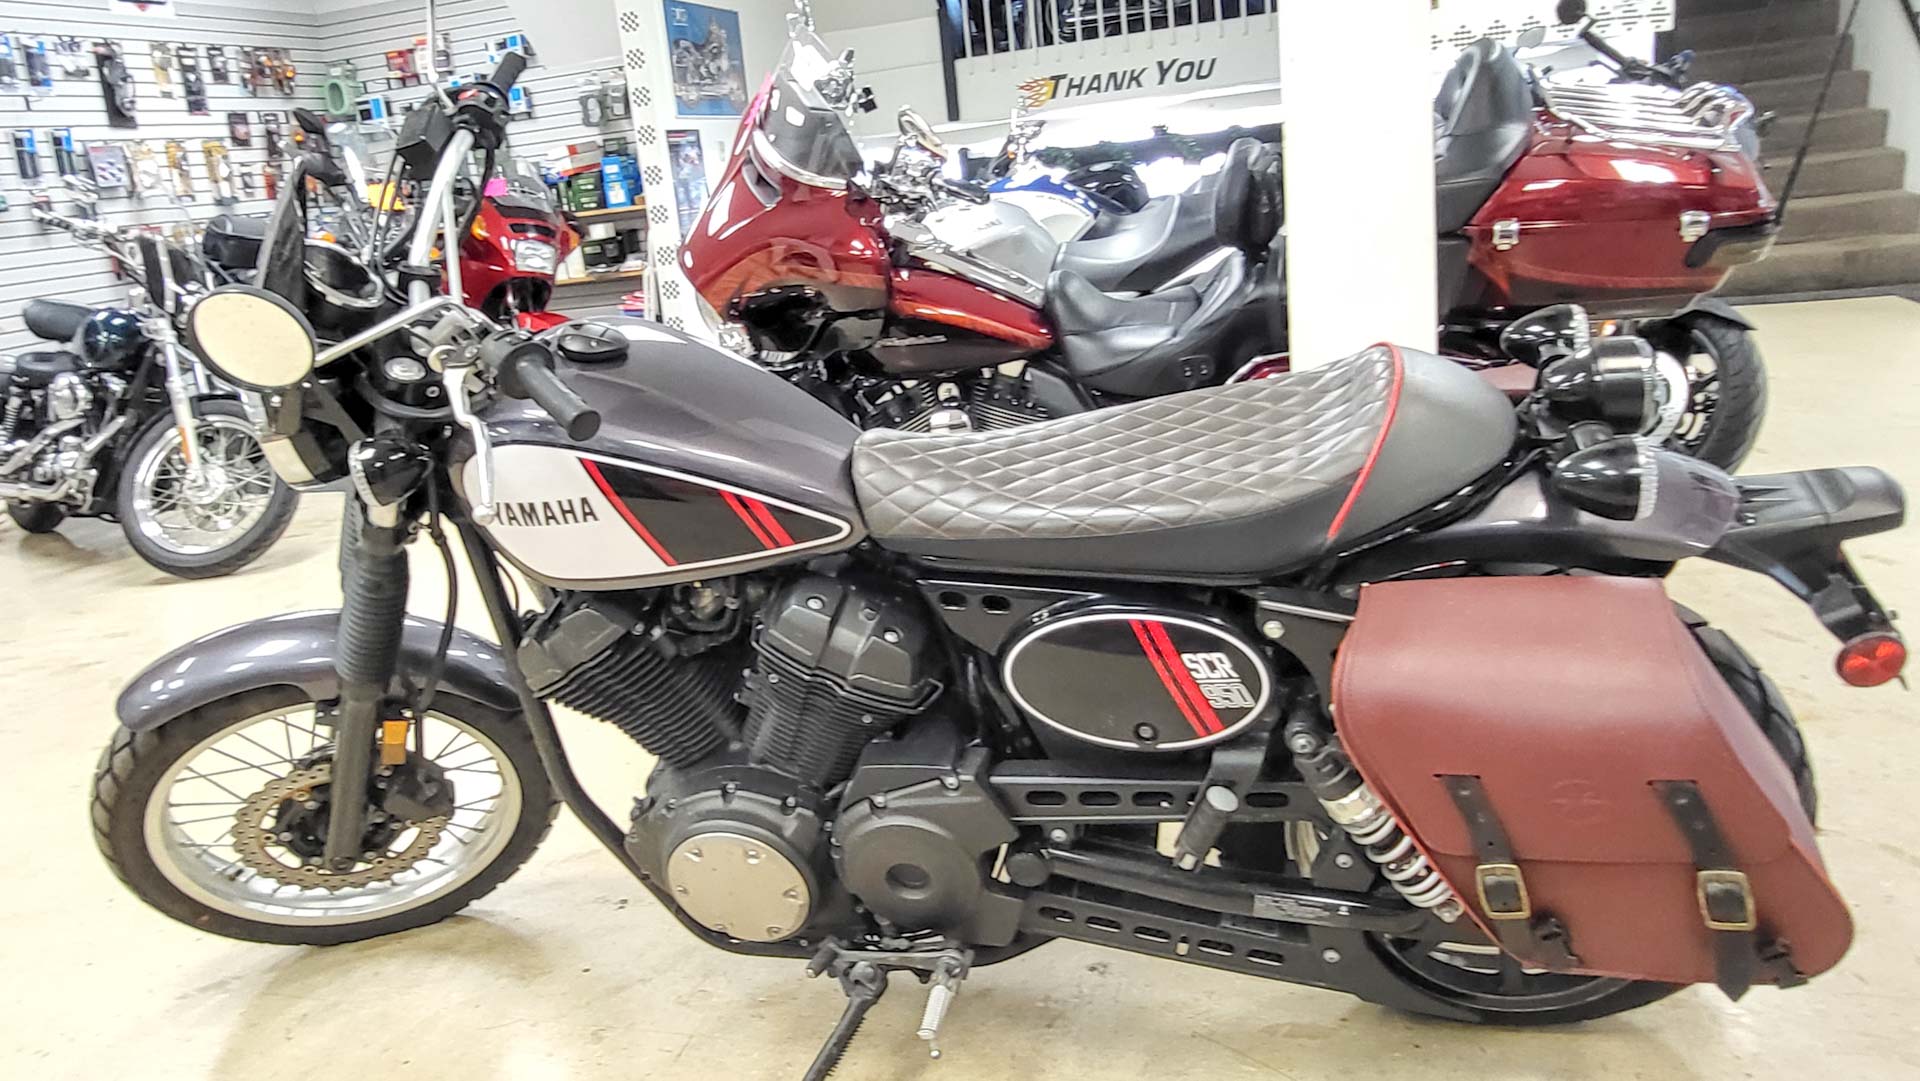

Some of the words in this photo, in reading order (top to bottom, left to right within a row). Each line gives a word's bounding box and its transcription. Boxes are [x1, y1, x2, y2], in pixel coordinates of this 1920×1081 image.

[1050, 67, 1149, 99] THANK
[1156, 57, 1217, 85] YOU
[495, 497, 600, 526] YAMAHA
[1180, 652, 1240, 679] SCR
[1200, 683, 1256, 709] 950
